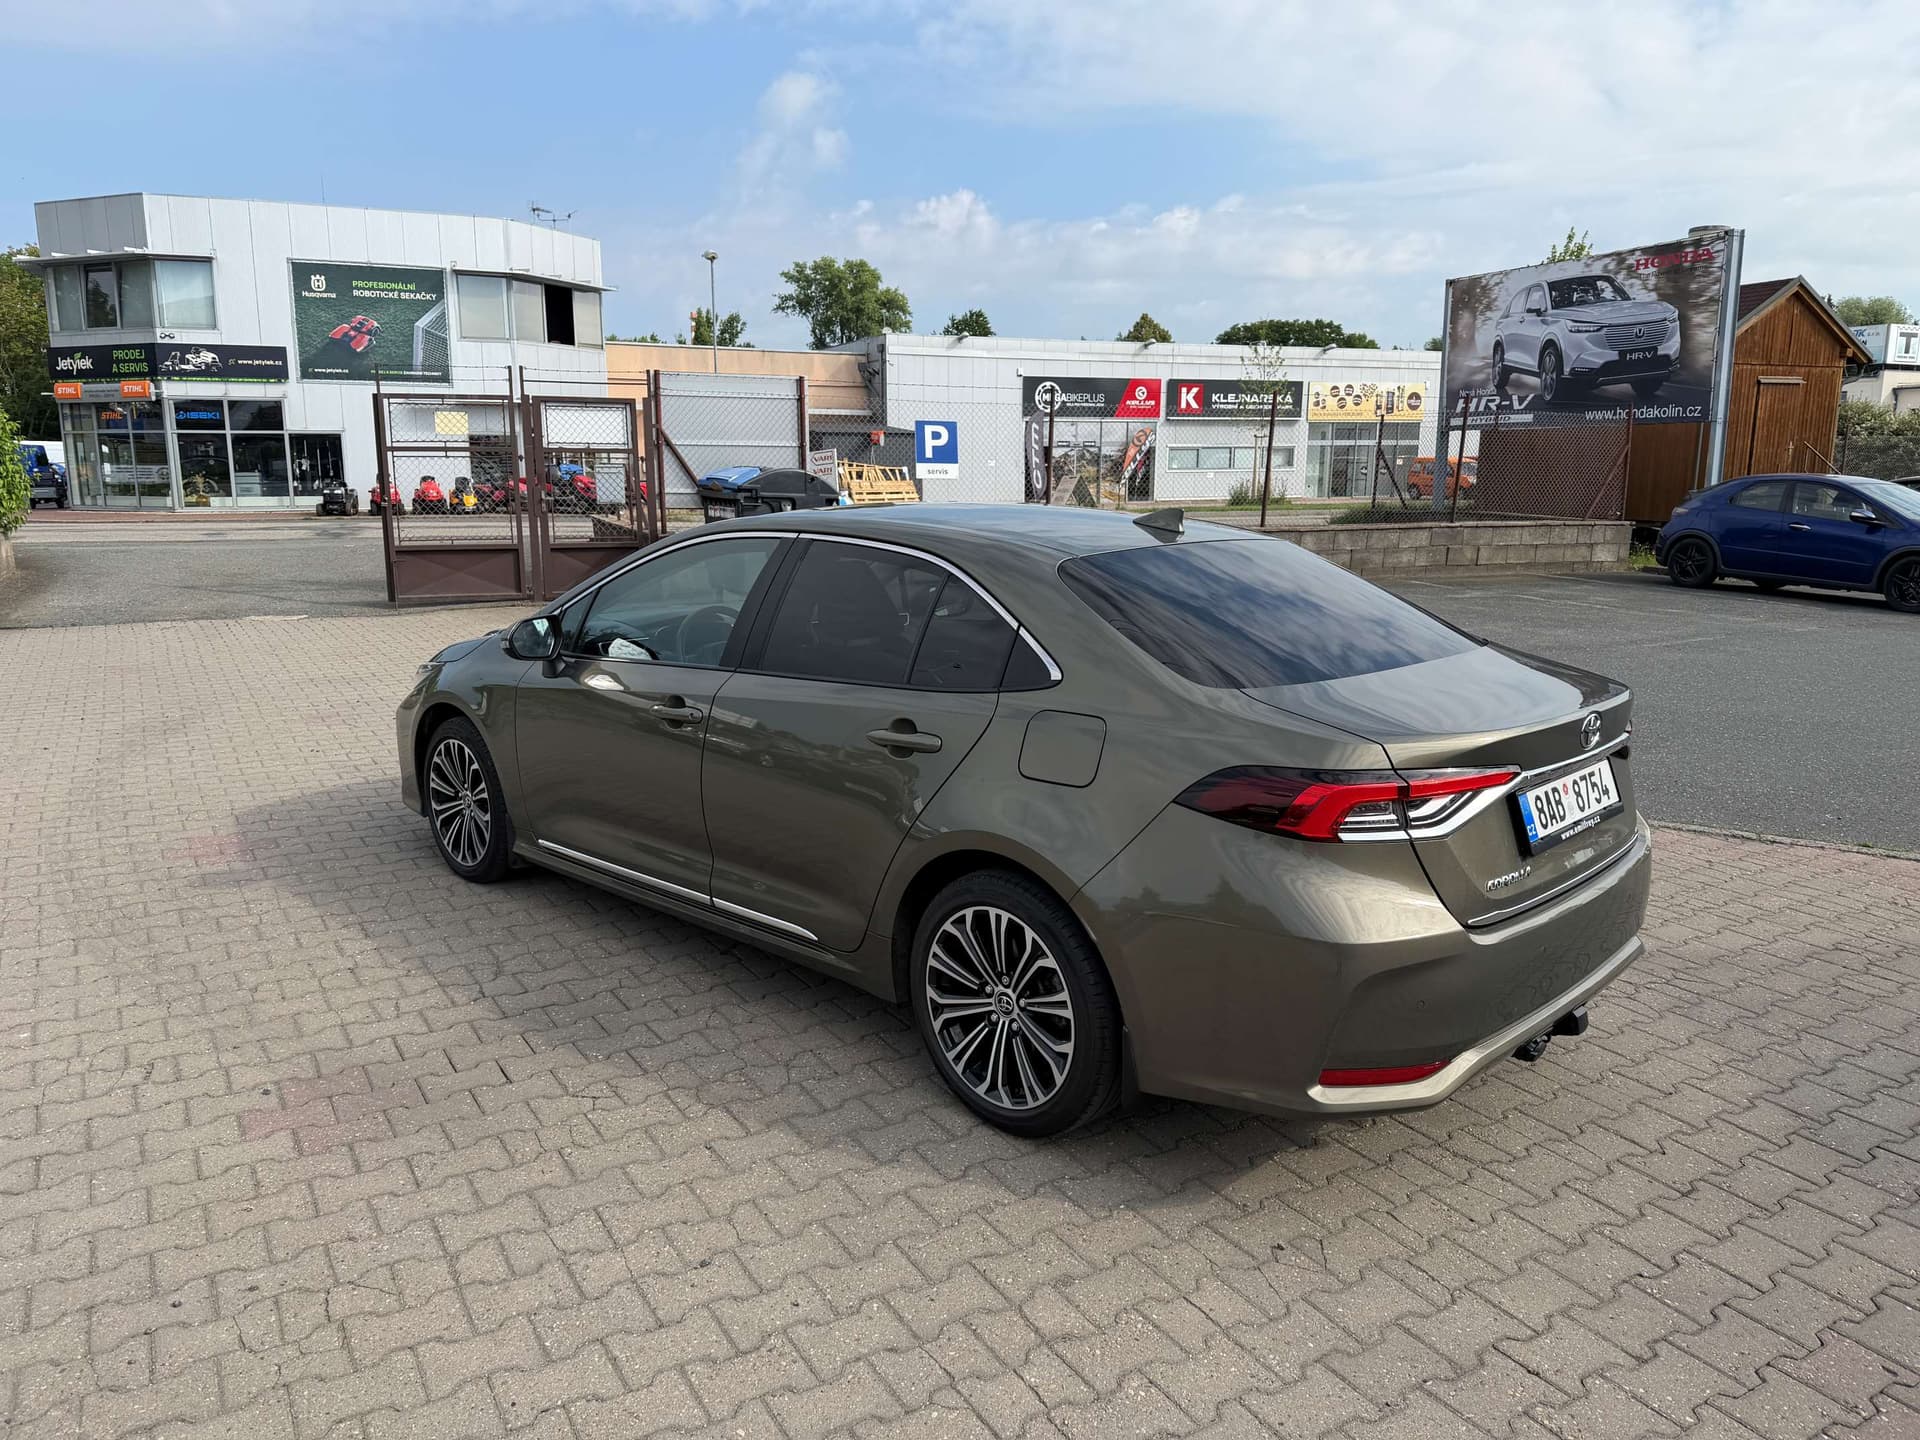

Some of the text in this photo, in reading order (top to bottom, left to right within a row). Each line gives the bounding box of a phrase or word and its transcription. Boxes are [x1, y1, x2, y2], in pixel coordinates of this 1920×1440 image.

[1634, 247, 1713, 271] HONDA
[352, 280, 416, 290] PROFESIONÁLNÍ
[302, 291, 337, 299] Husqvarna
[353, 289, 437, 301] ROBOTICKÉ SEKAČKY
[113, 349, 145, 360] PRODEJ
[1626, 351, 1654, 361] HR-V
[112, 362, 149, 373] A SERVIS
[57, 386, 77, 395] STIHL
[123, 385, 144, 394] STIHL
[1455, 393, 1535, 414] HR-V
[101, 411, 123, 420] STIHL
[187, 411, 220, 419] ISEKI
[1585, 403, 1702, 420] www.hondakolin.cz
[924, 424, 949, 459] P
[1534, 767, 1611, 830] 8AB 8754
[1526, 823, 1537, 836] CZ
